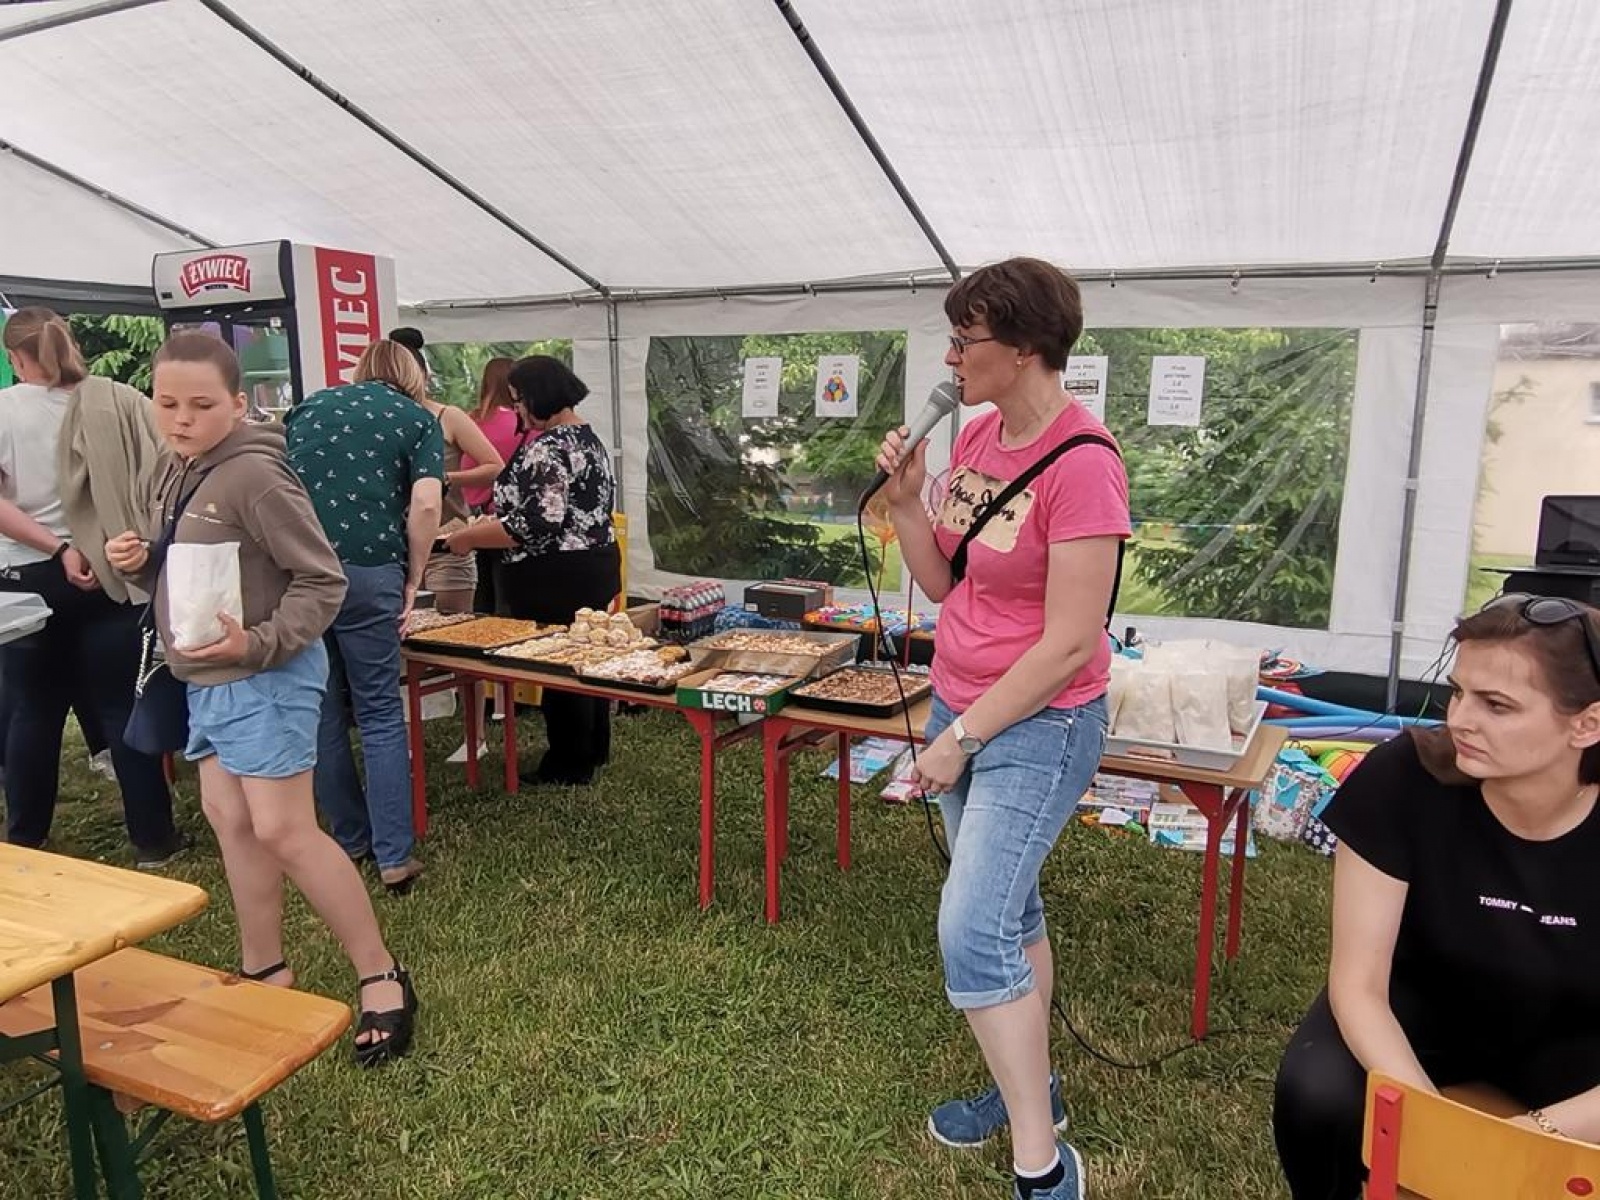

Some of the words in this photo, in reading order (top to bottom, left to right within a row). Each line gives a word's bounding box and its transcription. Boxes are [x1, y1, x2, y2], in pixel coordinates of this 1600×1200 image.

[187, 258, 243, 284] ŻYWIEC
[702, 691, 751, 712] LECH
[1479, 896, 1518, 910] TOMMY
[1540, 915, 1577, 926] JEANS
